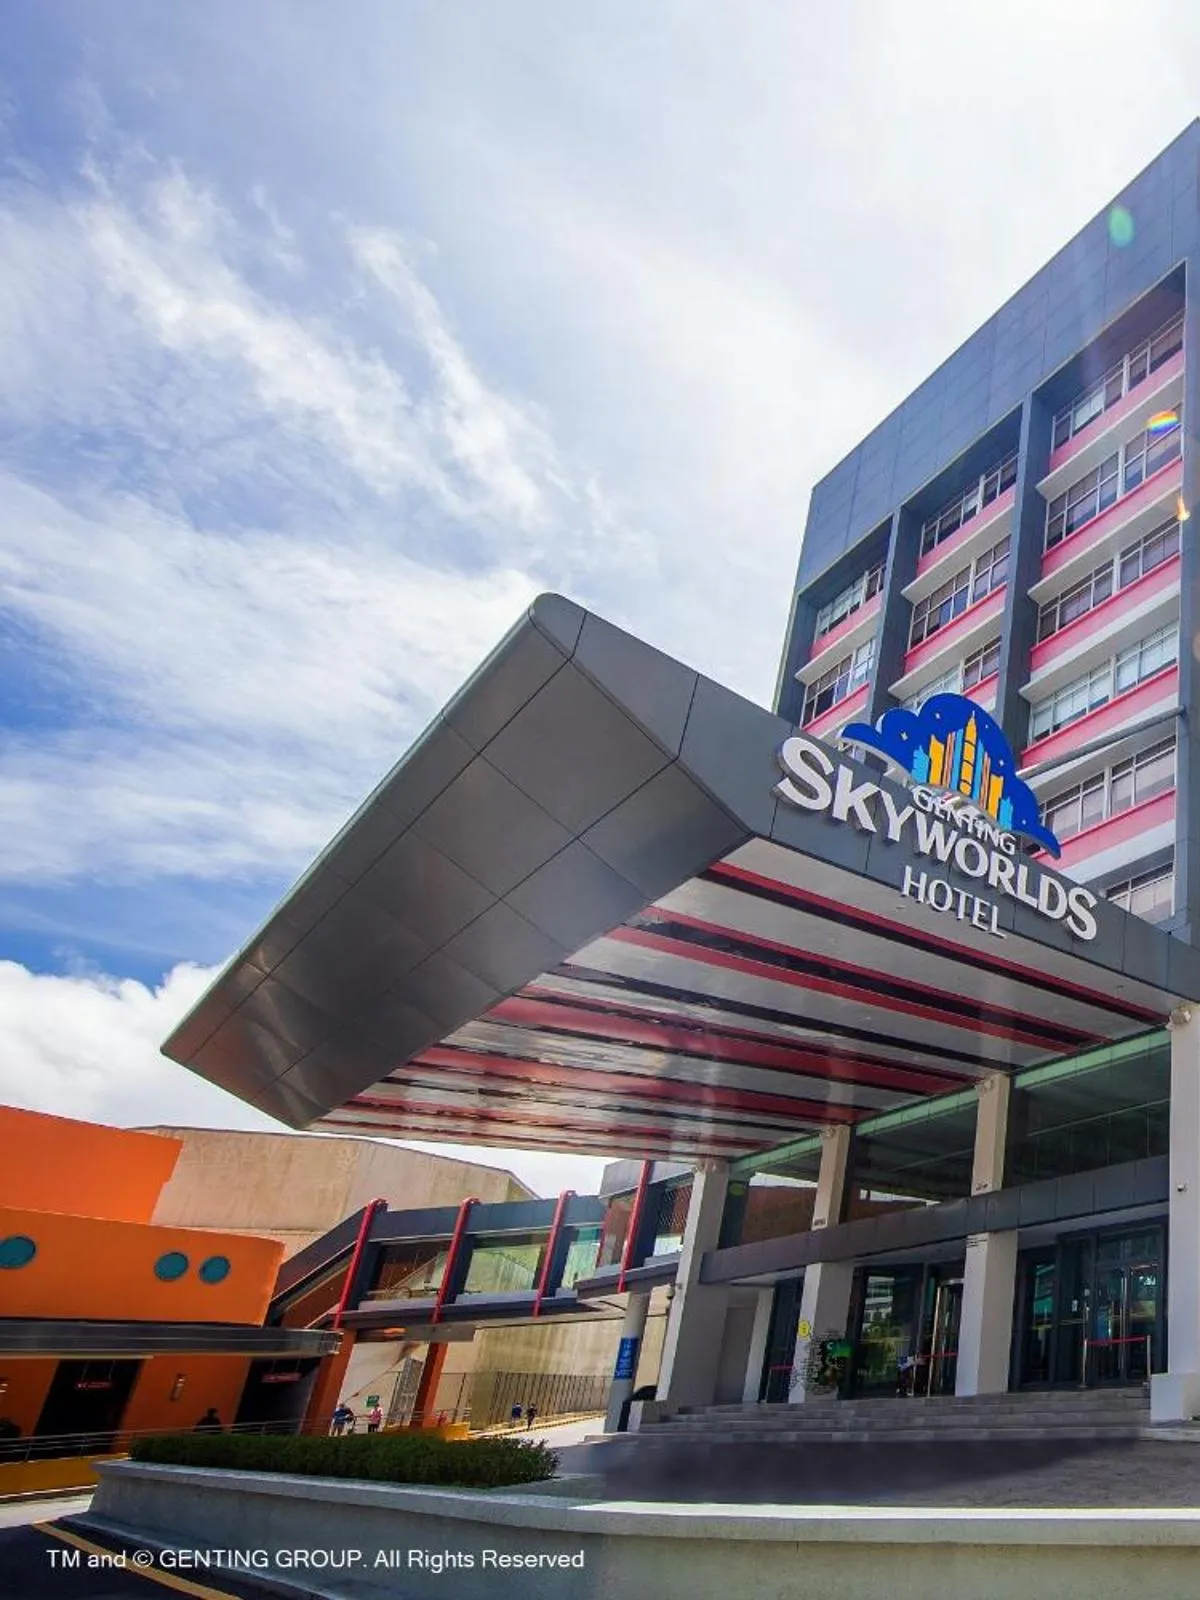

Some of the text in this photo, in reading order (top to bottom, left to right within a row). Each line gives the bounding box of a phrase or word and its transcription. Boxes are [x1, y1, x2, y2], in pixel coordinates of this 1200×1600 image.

[774, 736, 1098, 941] SKYWORLDS
[910, 784, 1017, 856] GENTING
[901, 864, 1007, 938] HOTEL
